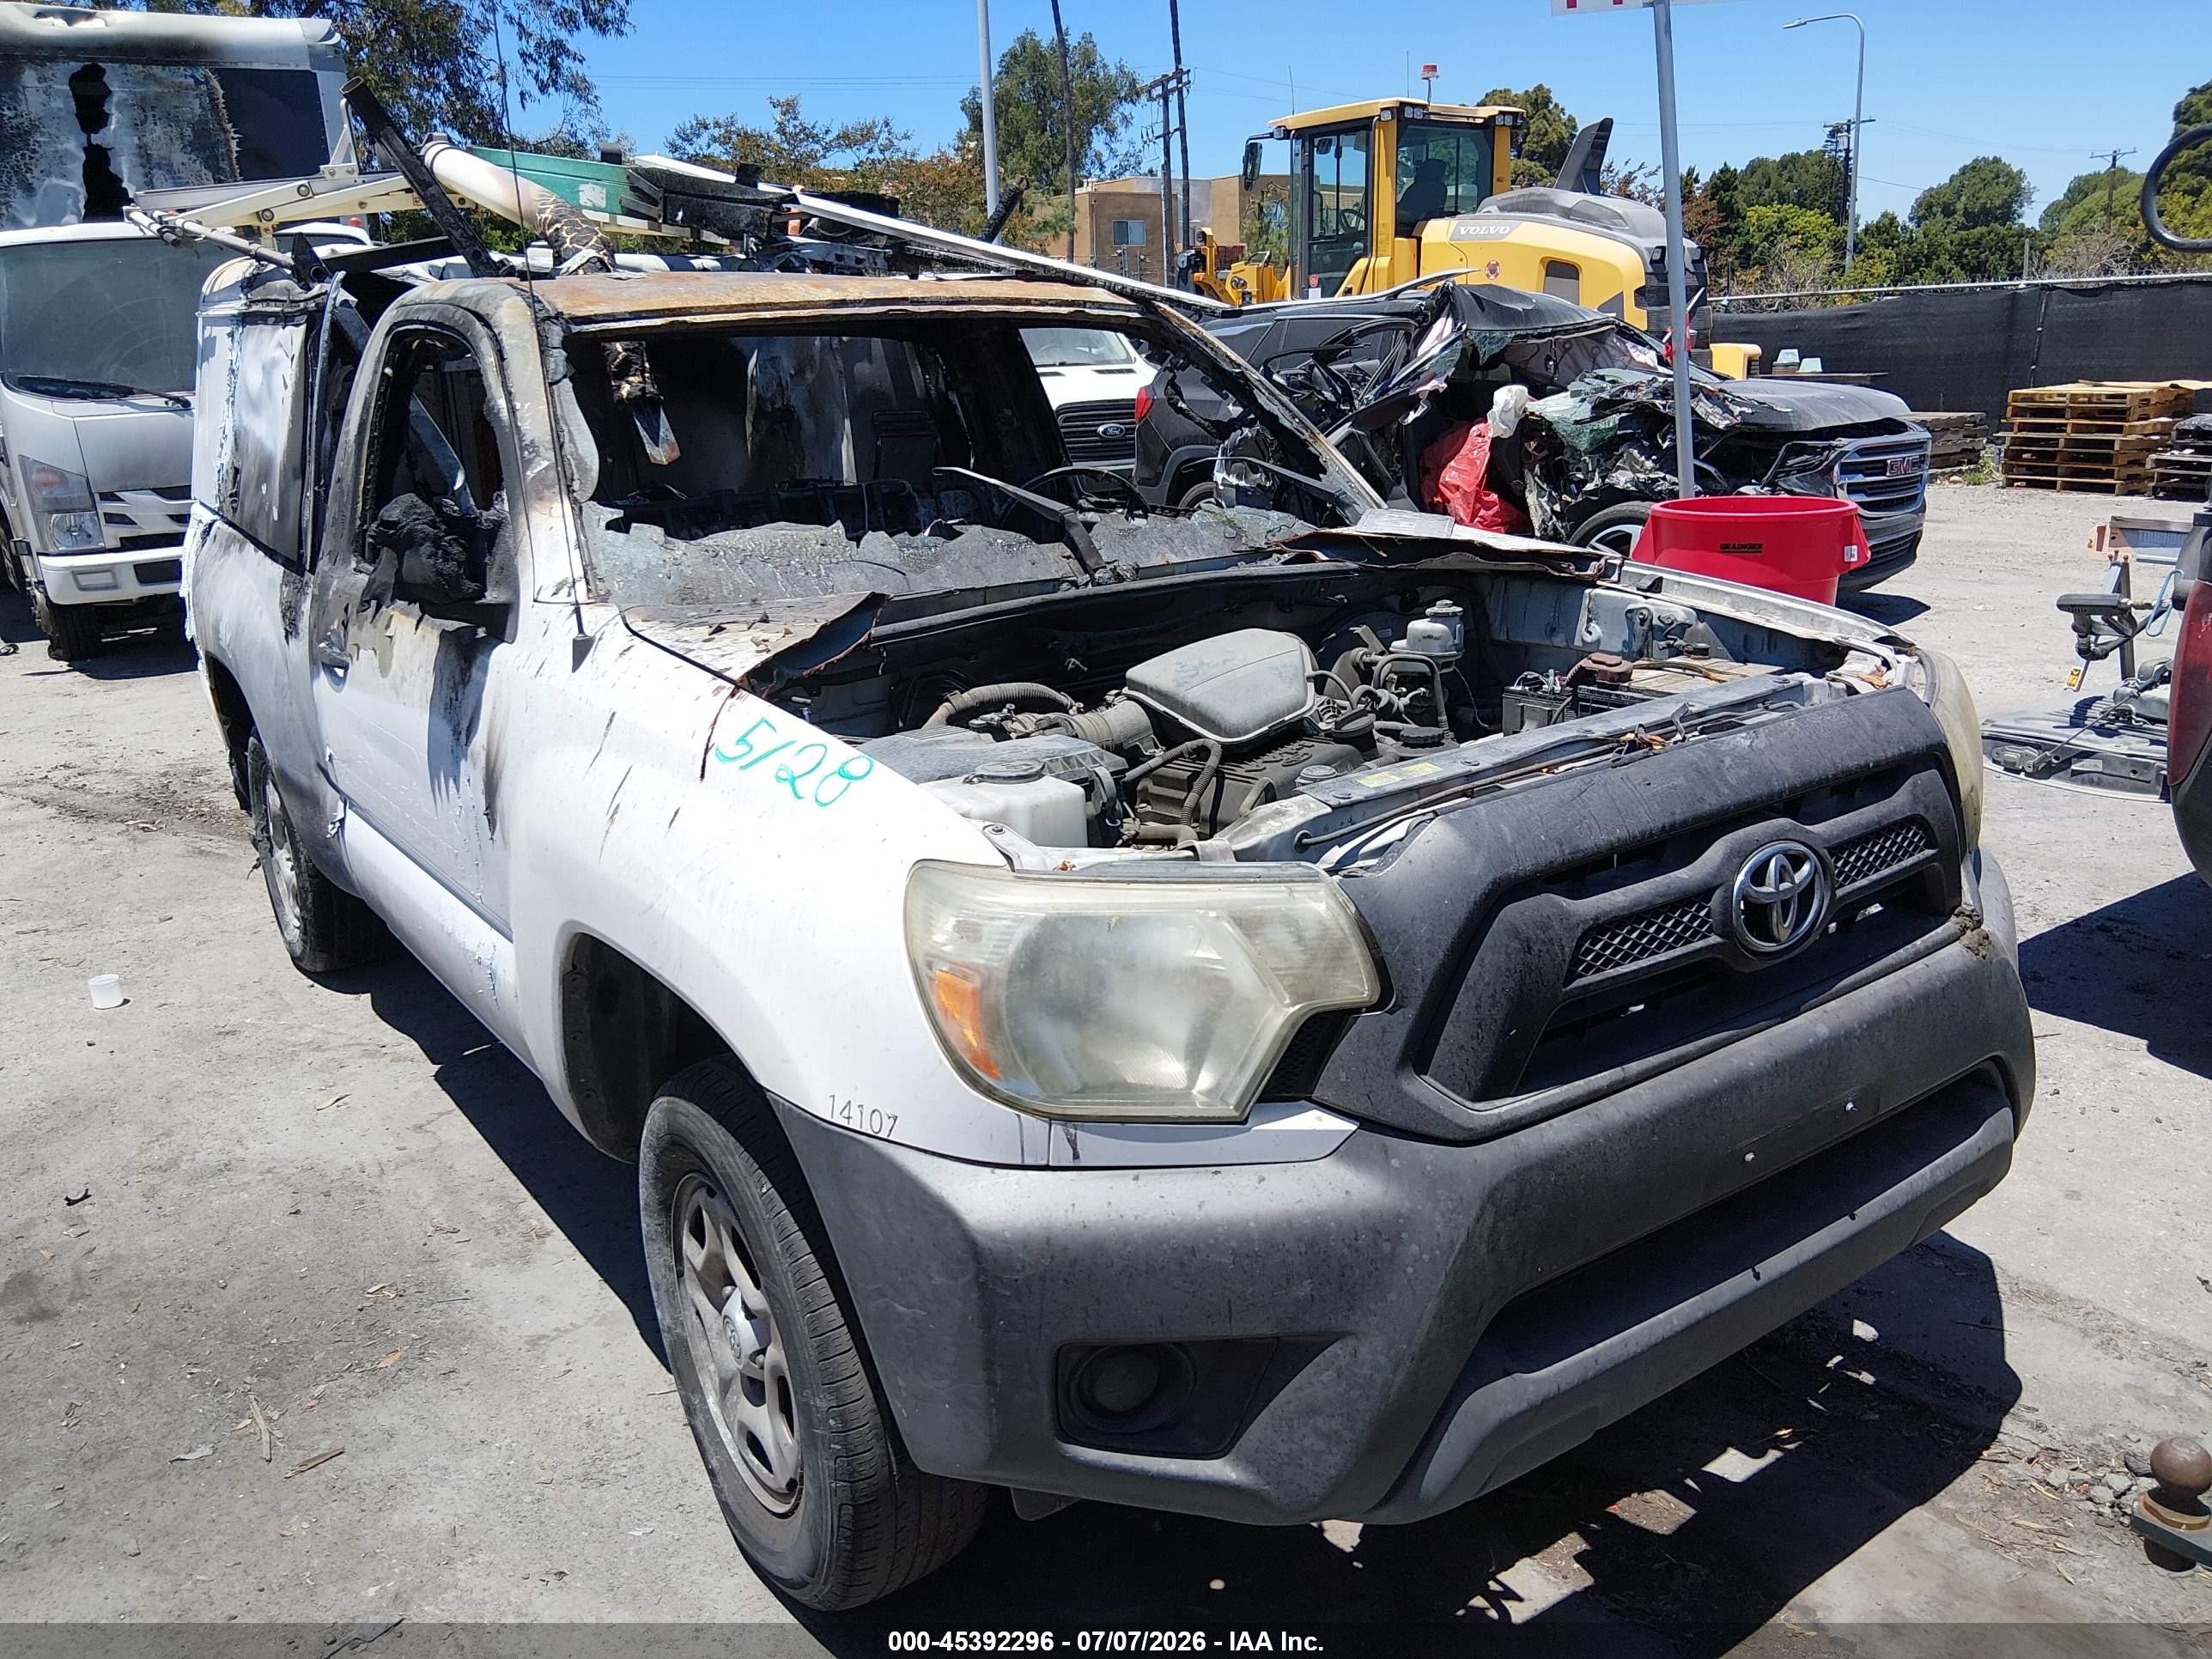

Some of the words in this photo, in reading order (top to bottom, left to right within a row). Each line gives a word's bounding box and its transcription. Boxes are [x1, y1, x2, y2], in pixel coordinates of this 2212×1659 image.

[1459, 226, 1510, 235] VOLVO
[1886, 456, 1920, 476] GMC
[715, 716, 875, 806] 5/28
[829, 1094, 899, 1138] 14107
